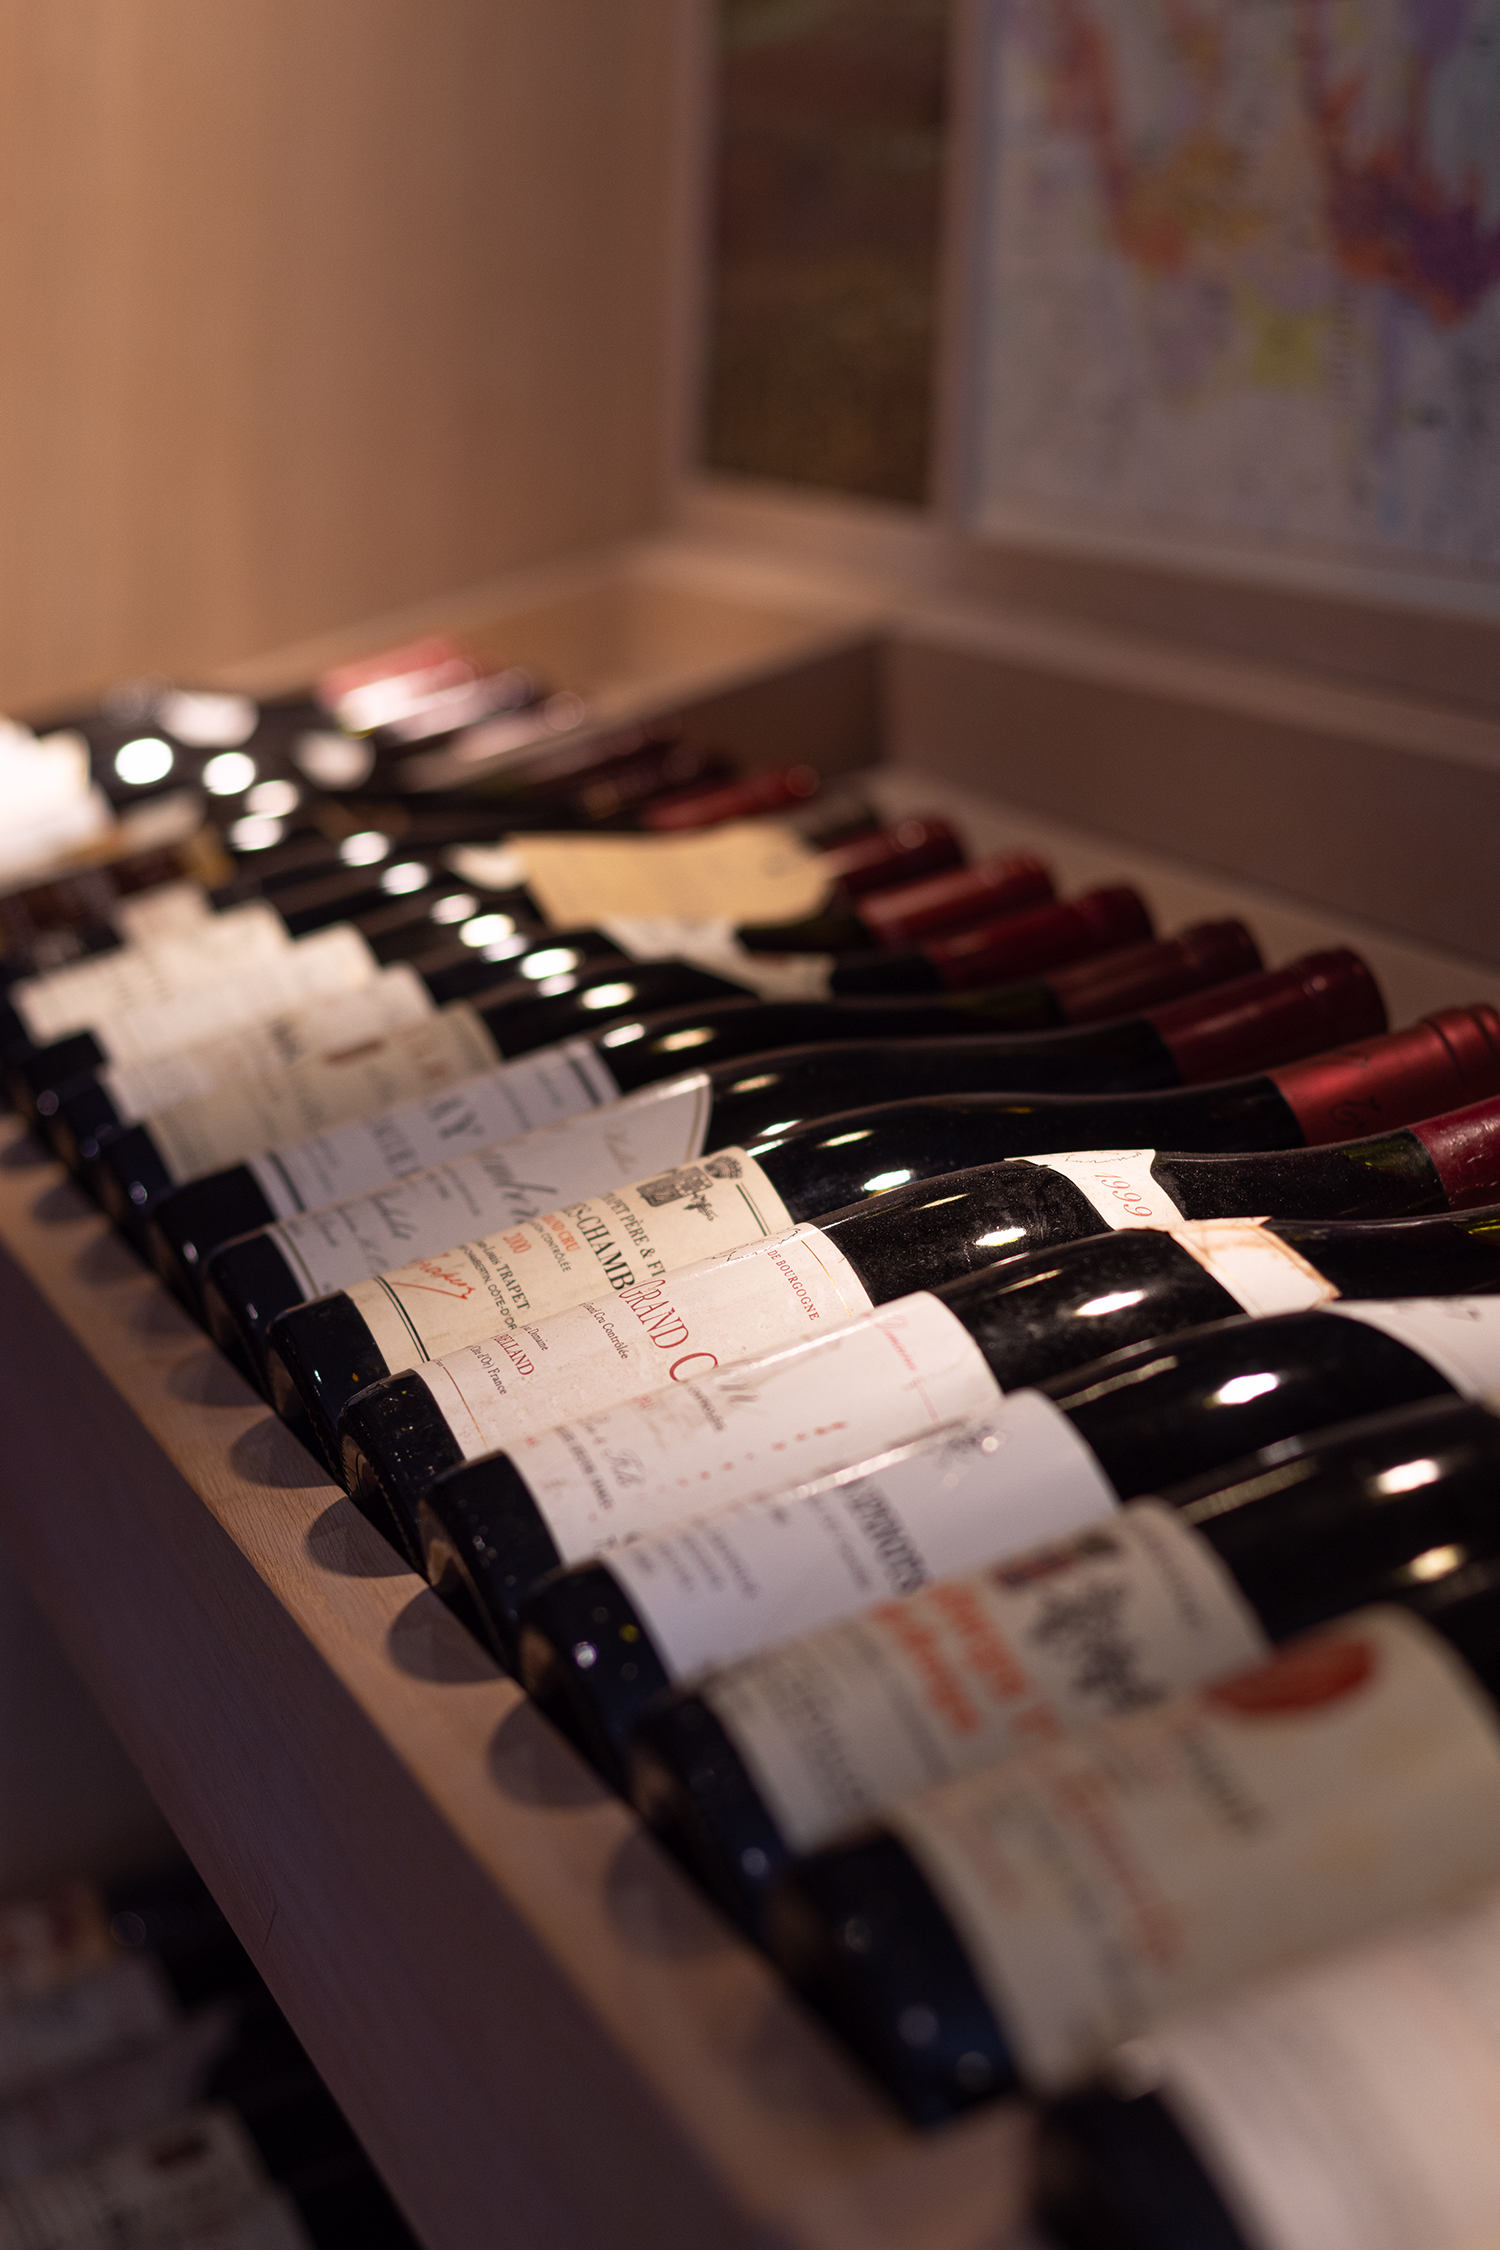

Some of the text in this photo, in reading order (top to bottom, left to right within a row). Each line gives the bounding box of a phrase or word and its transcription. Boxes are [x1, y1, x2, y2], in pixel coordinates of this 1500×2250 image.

[1094, 1172, 1152, 1217] 1999
[540, 1232, 572, 1273] CONTRÔLÉE
[557, 1228, 581, 1252] CRU
[620, 1213, 650, 1246] PÈRE
[639, 1247, 656, 1259] &
[496, 1264, 531, 1309] TRAPET
[767, 1249, 820, 1321] DE BOURGOGNE
[593, 1311, 606, 1324] Cru
[602, 1322, 629, 1360] Contrôlée
[618, 1279, 689, 1350] GRAND
[527, 1328, 549, 1351] Domaine
[487, 1367, 507, 1395] France
